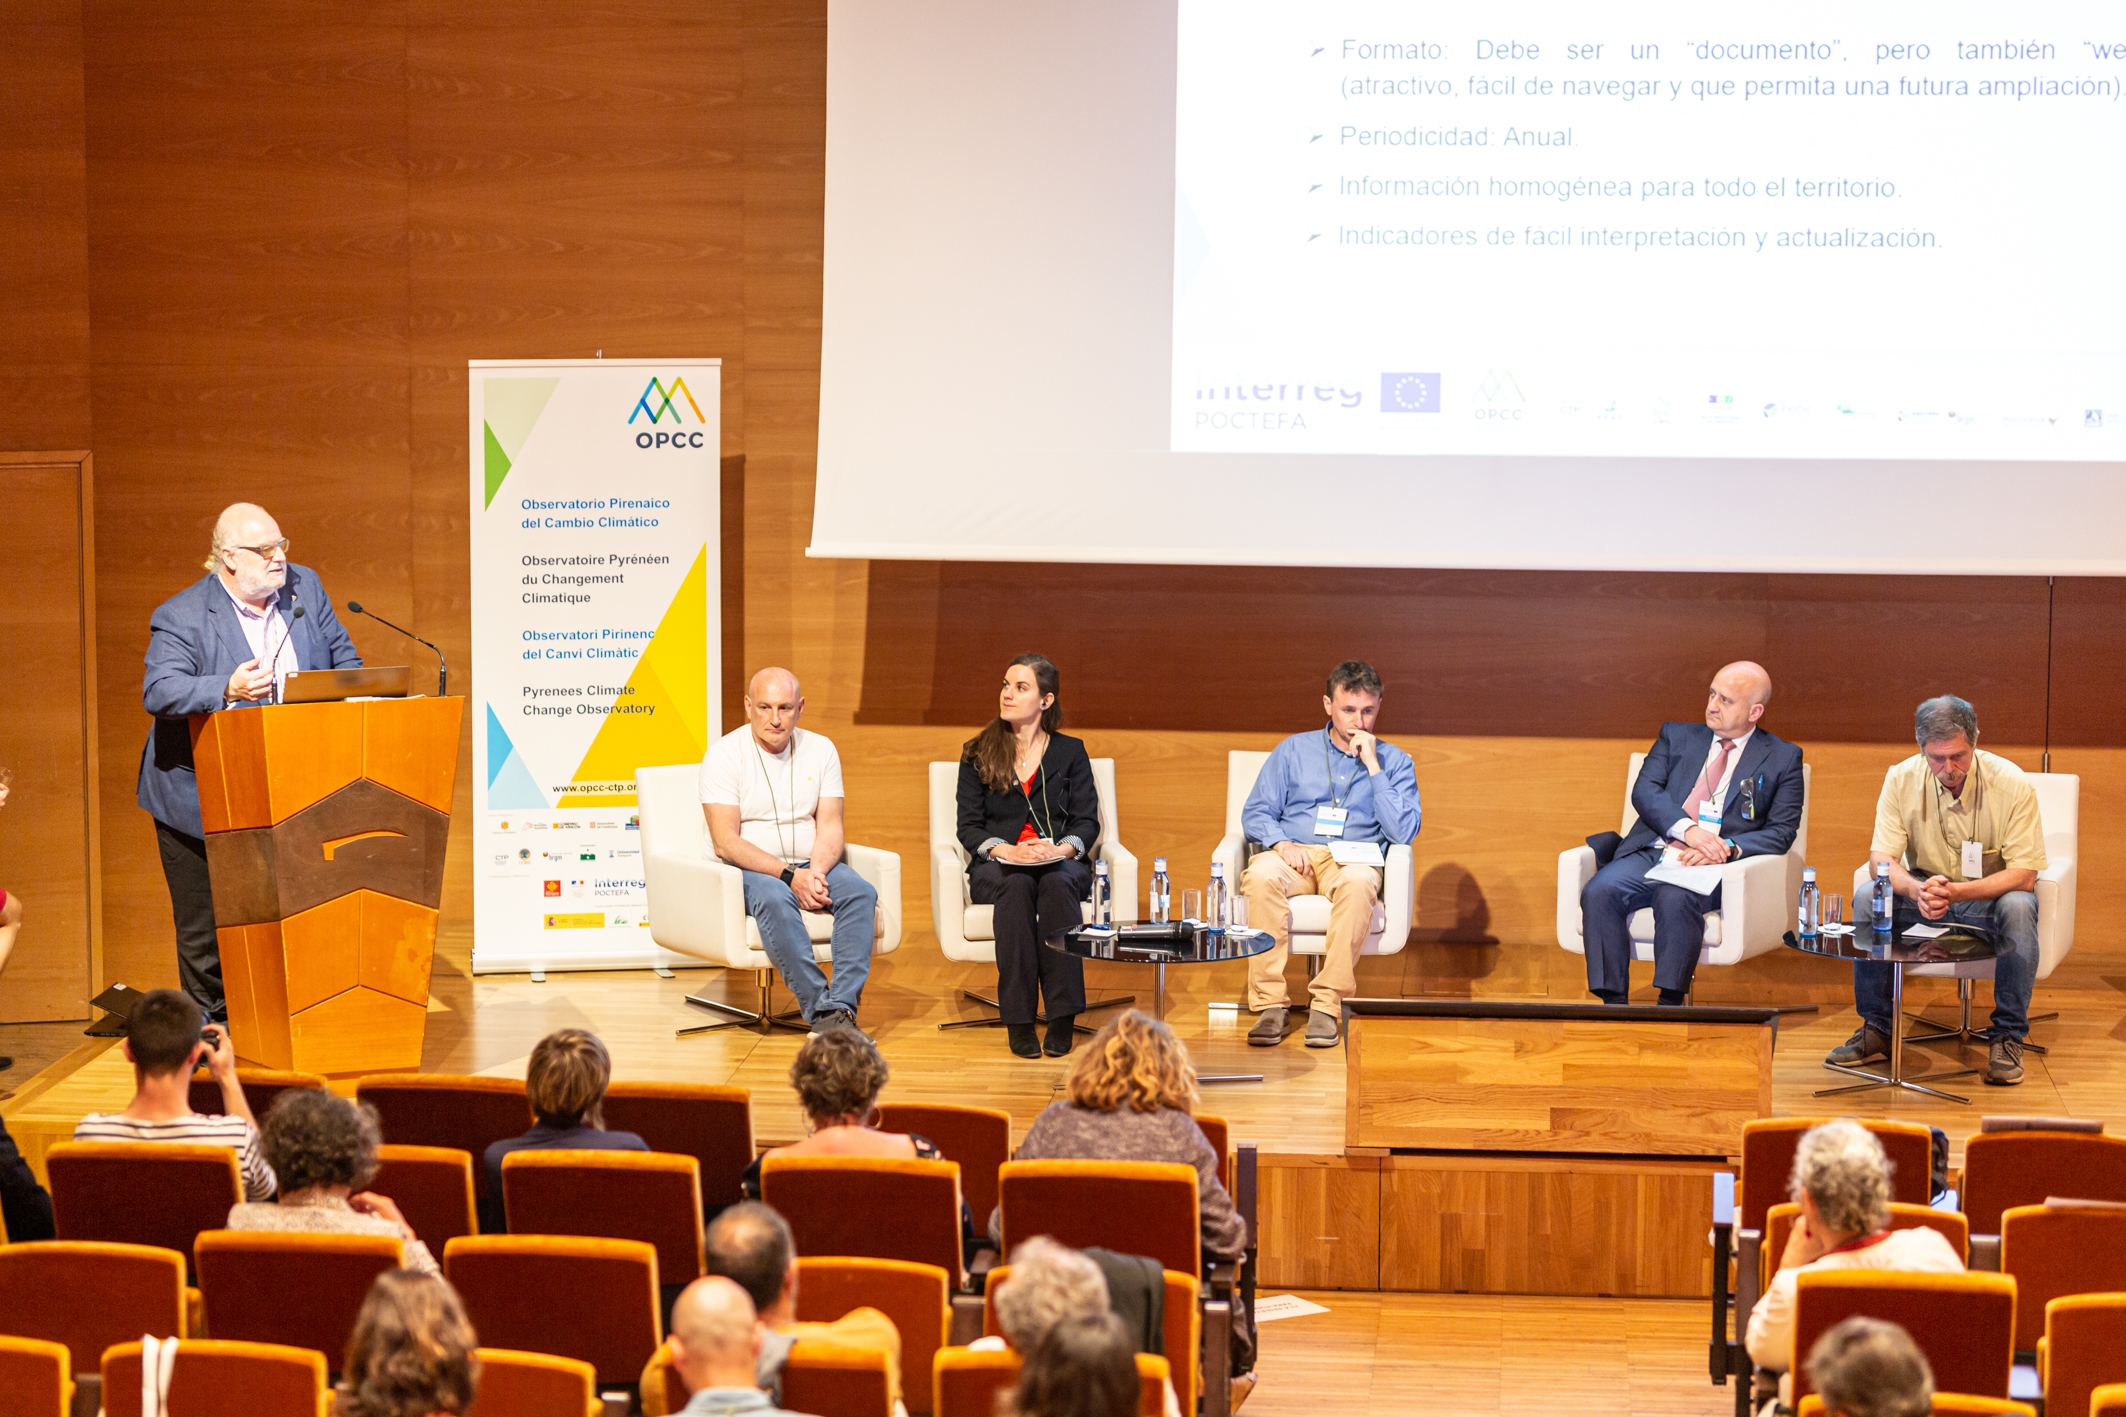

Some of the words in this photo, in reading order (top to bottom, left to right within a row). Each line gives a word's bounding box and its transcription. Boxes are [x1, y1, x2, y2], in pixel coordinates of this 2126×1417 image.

[1342, 38, 1448, 61] Formato:
[1476, 38, 1541, 61] Debe
[1566, 43, 1605, 61] ser
[1630, 43, 1660, 61] un
[1686, 38, 1848, 63] “documento”,
[1875, 42, 1931, 66] pero
[1956, 38, 2056, 61] también
[1341, 75, 1459, 101] (atractivo,
[1467, 75, 1516, 96] fácil
[1523, 75, 1554, 96] de
[1562, 79, 1662, 103] navegar
[1668, 79, 1683, 102] y
[1690, 79, 1736, 102] que
[1744, 75, 1836, 102] permita
[1844, 79, 1890, 97] una
[1898, 75, 1969, 97] futura
[1340, 125, 1495, 147] Periodicidad:
[1502, 125, 1579, 147] Anual.
[1340, 174, 1480, 197] Información
[1489, 175, 1633, 203] homogénea
[1641, 180, 1695, 203] para
[1703, 176, 1757, 198] todo
[1764, 176, 1786, 198] el
[1794, 176, 1902, 198] territorio.
[1339, 225, 1478, 246] Indicadores
[1486, 225, 1516, 246] de
[1523, 225, 1572, 246] fácil
[1580, 225, 1746, 253] interpretación
[1754, 231, 1769, 254] y
[1776, 227, 1943, 249] actualización.
[1195, 411, 1307, 430] POCTEFA
[1474, 408, 1522, 421] OPCC
[635, 431, 704, 449] OPCC
[521, 498, 606, 510] Observatorio
[609, 497, 671, 509] Pirenaico
[521, 517, 541, 529] del
[544, 517, 595, 529] Cambio
[598, 516, 659, 528] Climático
[521, 554, 605, 566] Observatoire
[609, 554, 671, 567] Pyrénéen
[521, 574, 538, 585] du
[541, 573, 624, 587] Changement
[521, 593, 591, 606] Climatique
[522, 629, 598, 641] Observatori
[602, 628, 655, 640] Pirinenc
[522, 648, 542, 660] del
[545, 648, 583, 660] Canvi
[586, 647, 639, 659] Climàtic
[522, 687, 583, 699] Pyrenees
[586, 685, 635, 696] Climate
[522, 705, 572, 717] Change
[576, 703, 656, 716] Observatory
[594, 878, 646, 889] Interreg
[594, 889, 630, 897] POCTEFA
